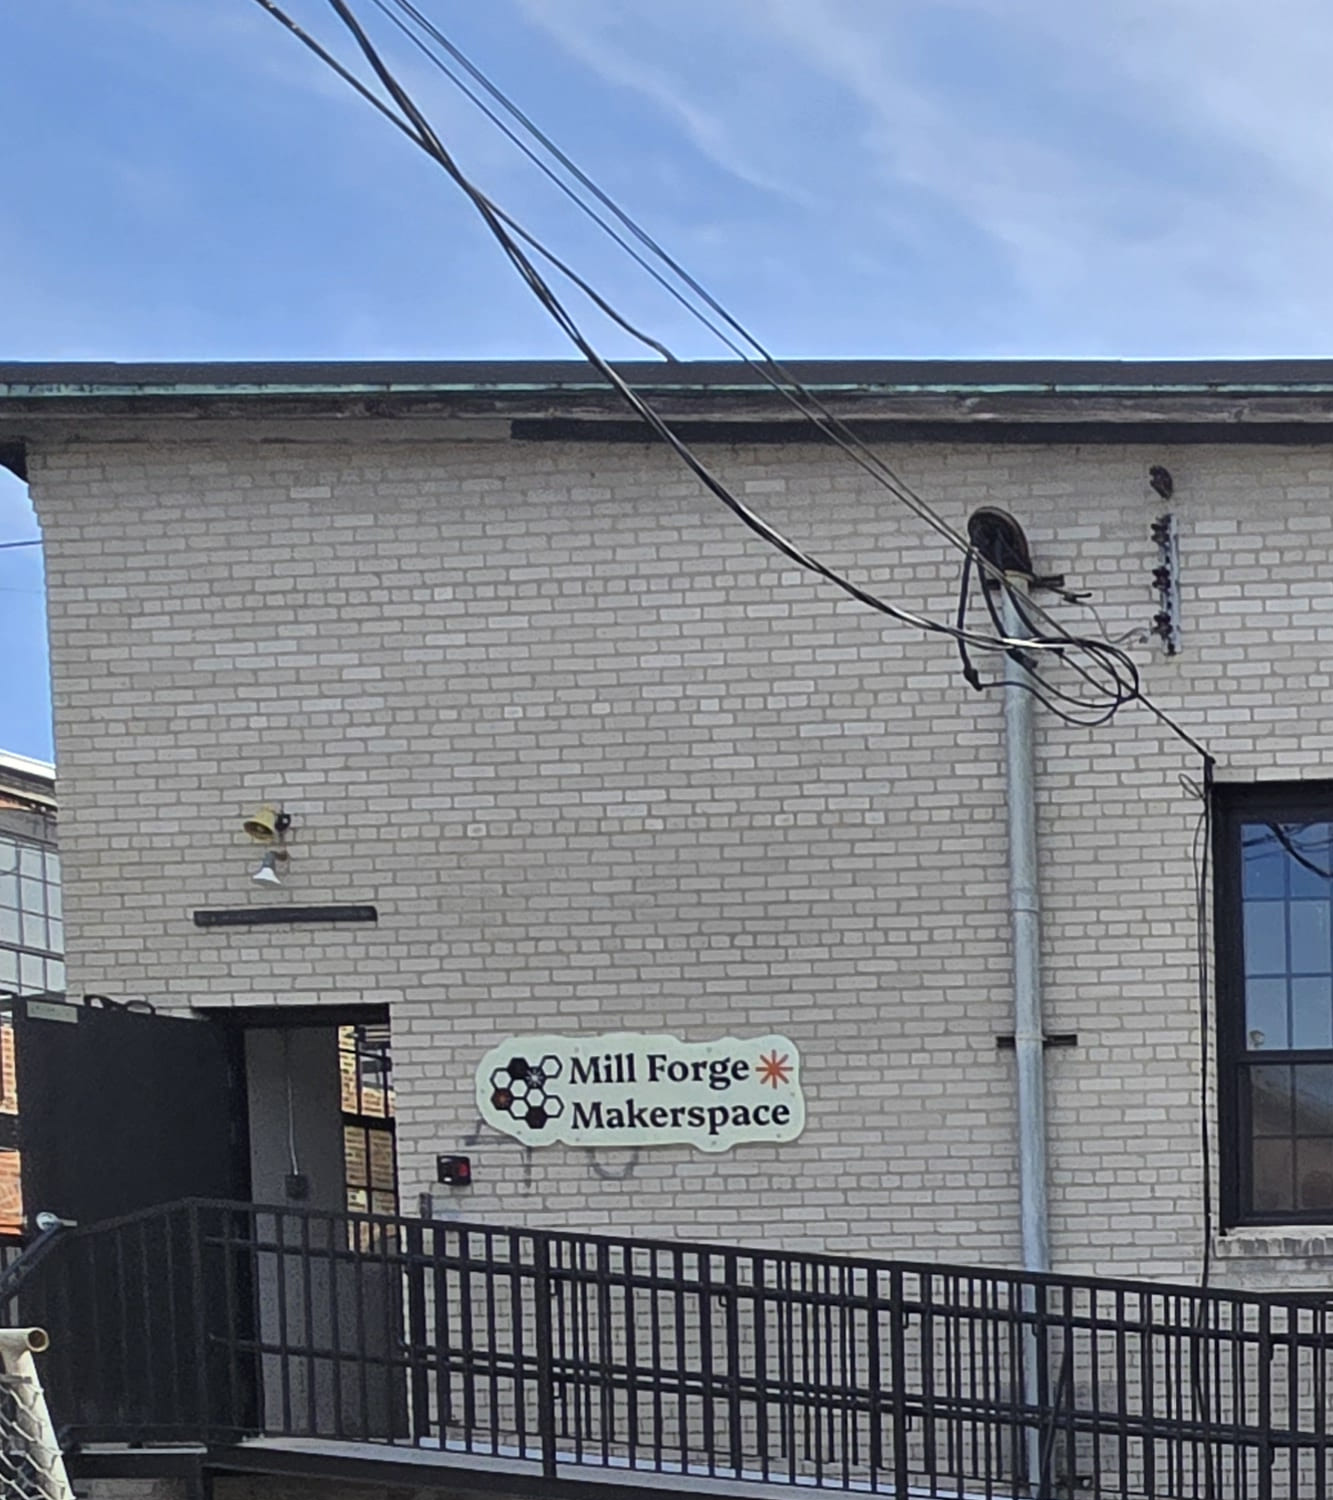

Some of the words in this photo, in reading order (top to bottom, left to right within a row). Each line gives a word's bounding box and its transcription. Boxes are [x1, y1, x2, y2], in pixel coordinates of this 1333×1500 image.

[568, 1053, 636, 1085] Mill
[647, 1053, 750, 1090] Forge
[571, 1098, 790, 1136] Makerspace
